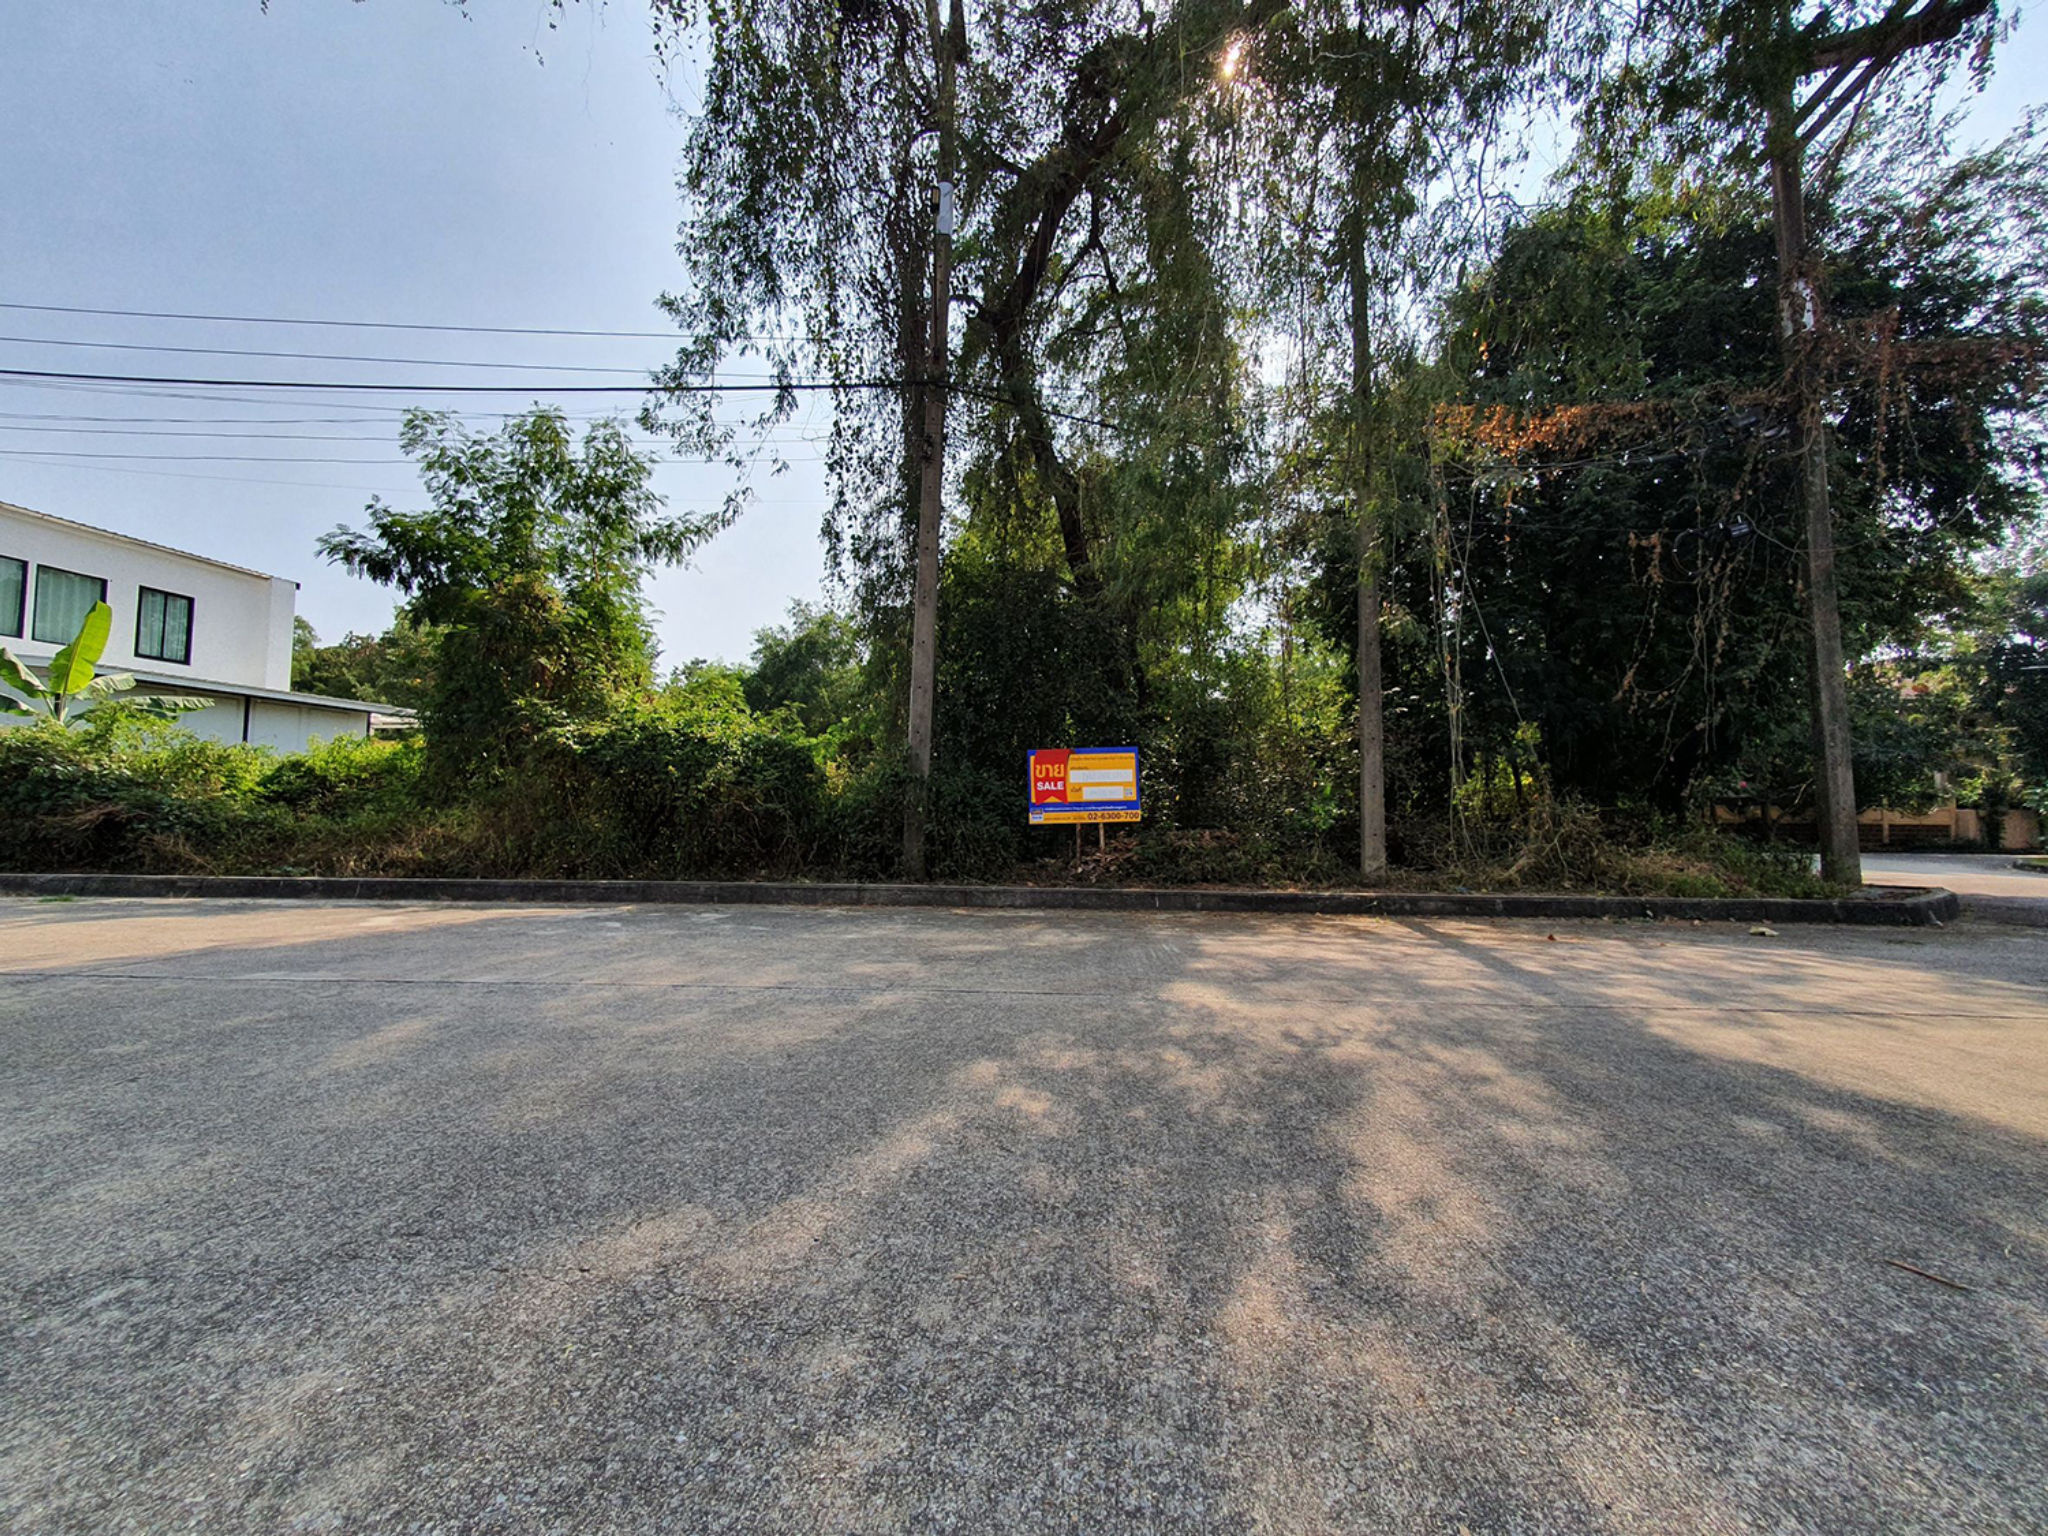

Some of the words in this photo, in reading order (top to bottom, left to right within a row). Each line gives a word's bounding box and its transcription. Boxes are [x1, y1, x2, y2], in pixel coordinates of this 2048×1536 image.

[1035, 763, 1065, 778] ขาย
[1036, 780, 1065, 791] SALE
[1087, 811, 1140, 821] 02-6300-700
